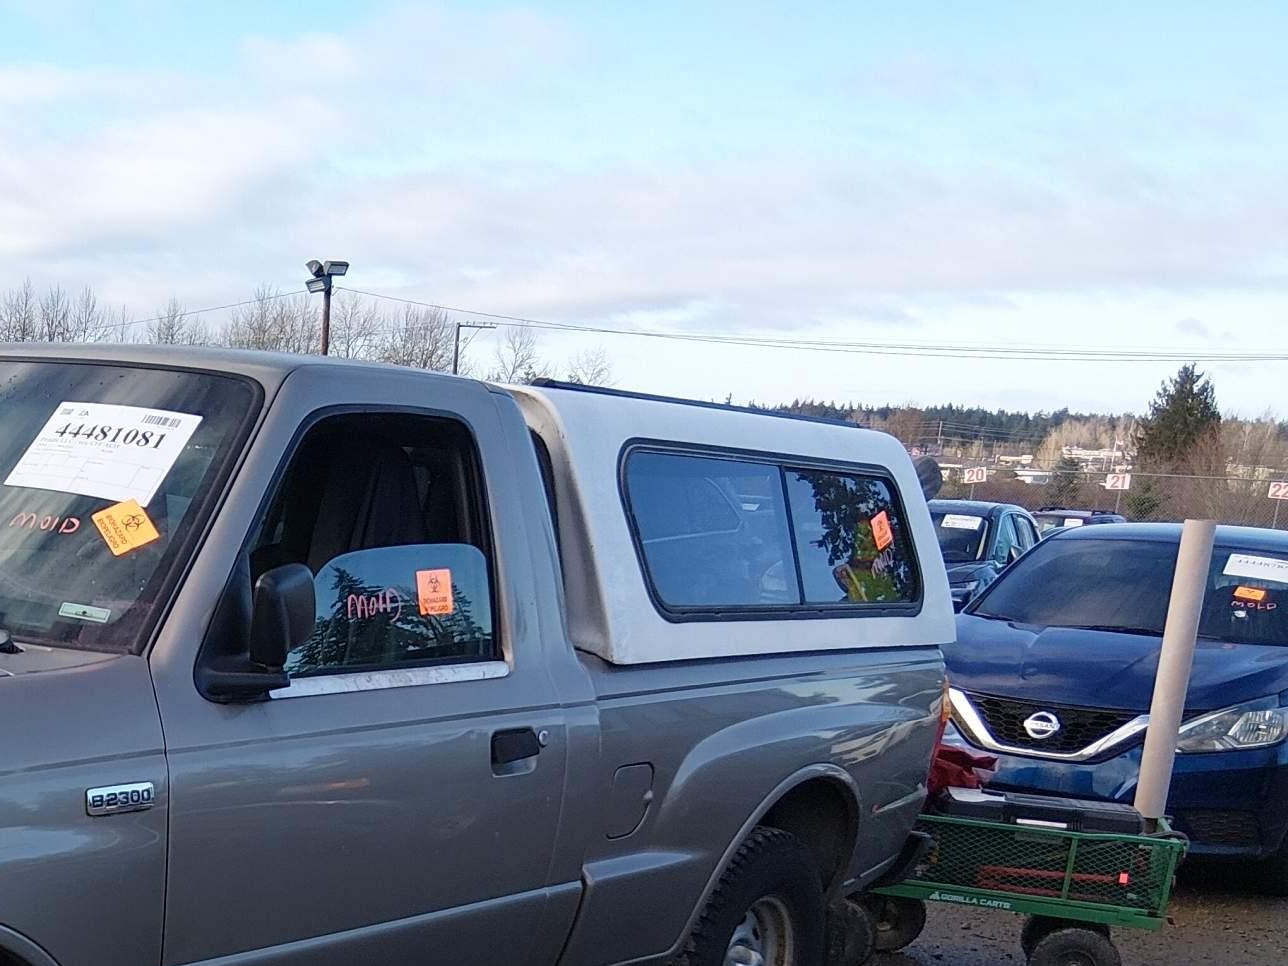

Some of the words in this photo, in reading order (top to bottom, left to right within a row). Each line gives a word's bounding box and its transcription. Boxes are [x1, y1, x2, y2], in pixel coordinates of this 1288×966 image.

[56, 423, 167, 449] 44481081
[967, 470, 983, 482] 20
[1111, 475, 1127, 488] 21
[1272, 486, 1288, 498] 22
[92, 789, 152, 808] B2300
[941, 893, 978, 904] GORILLA
